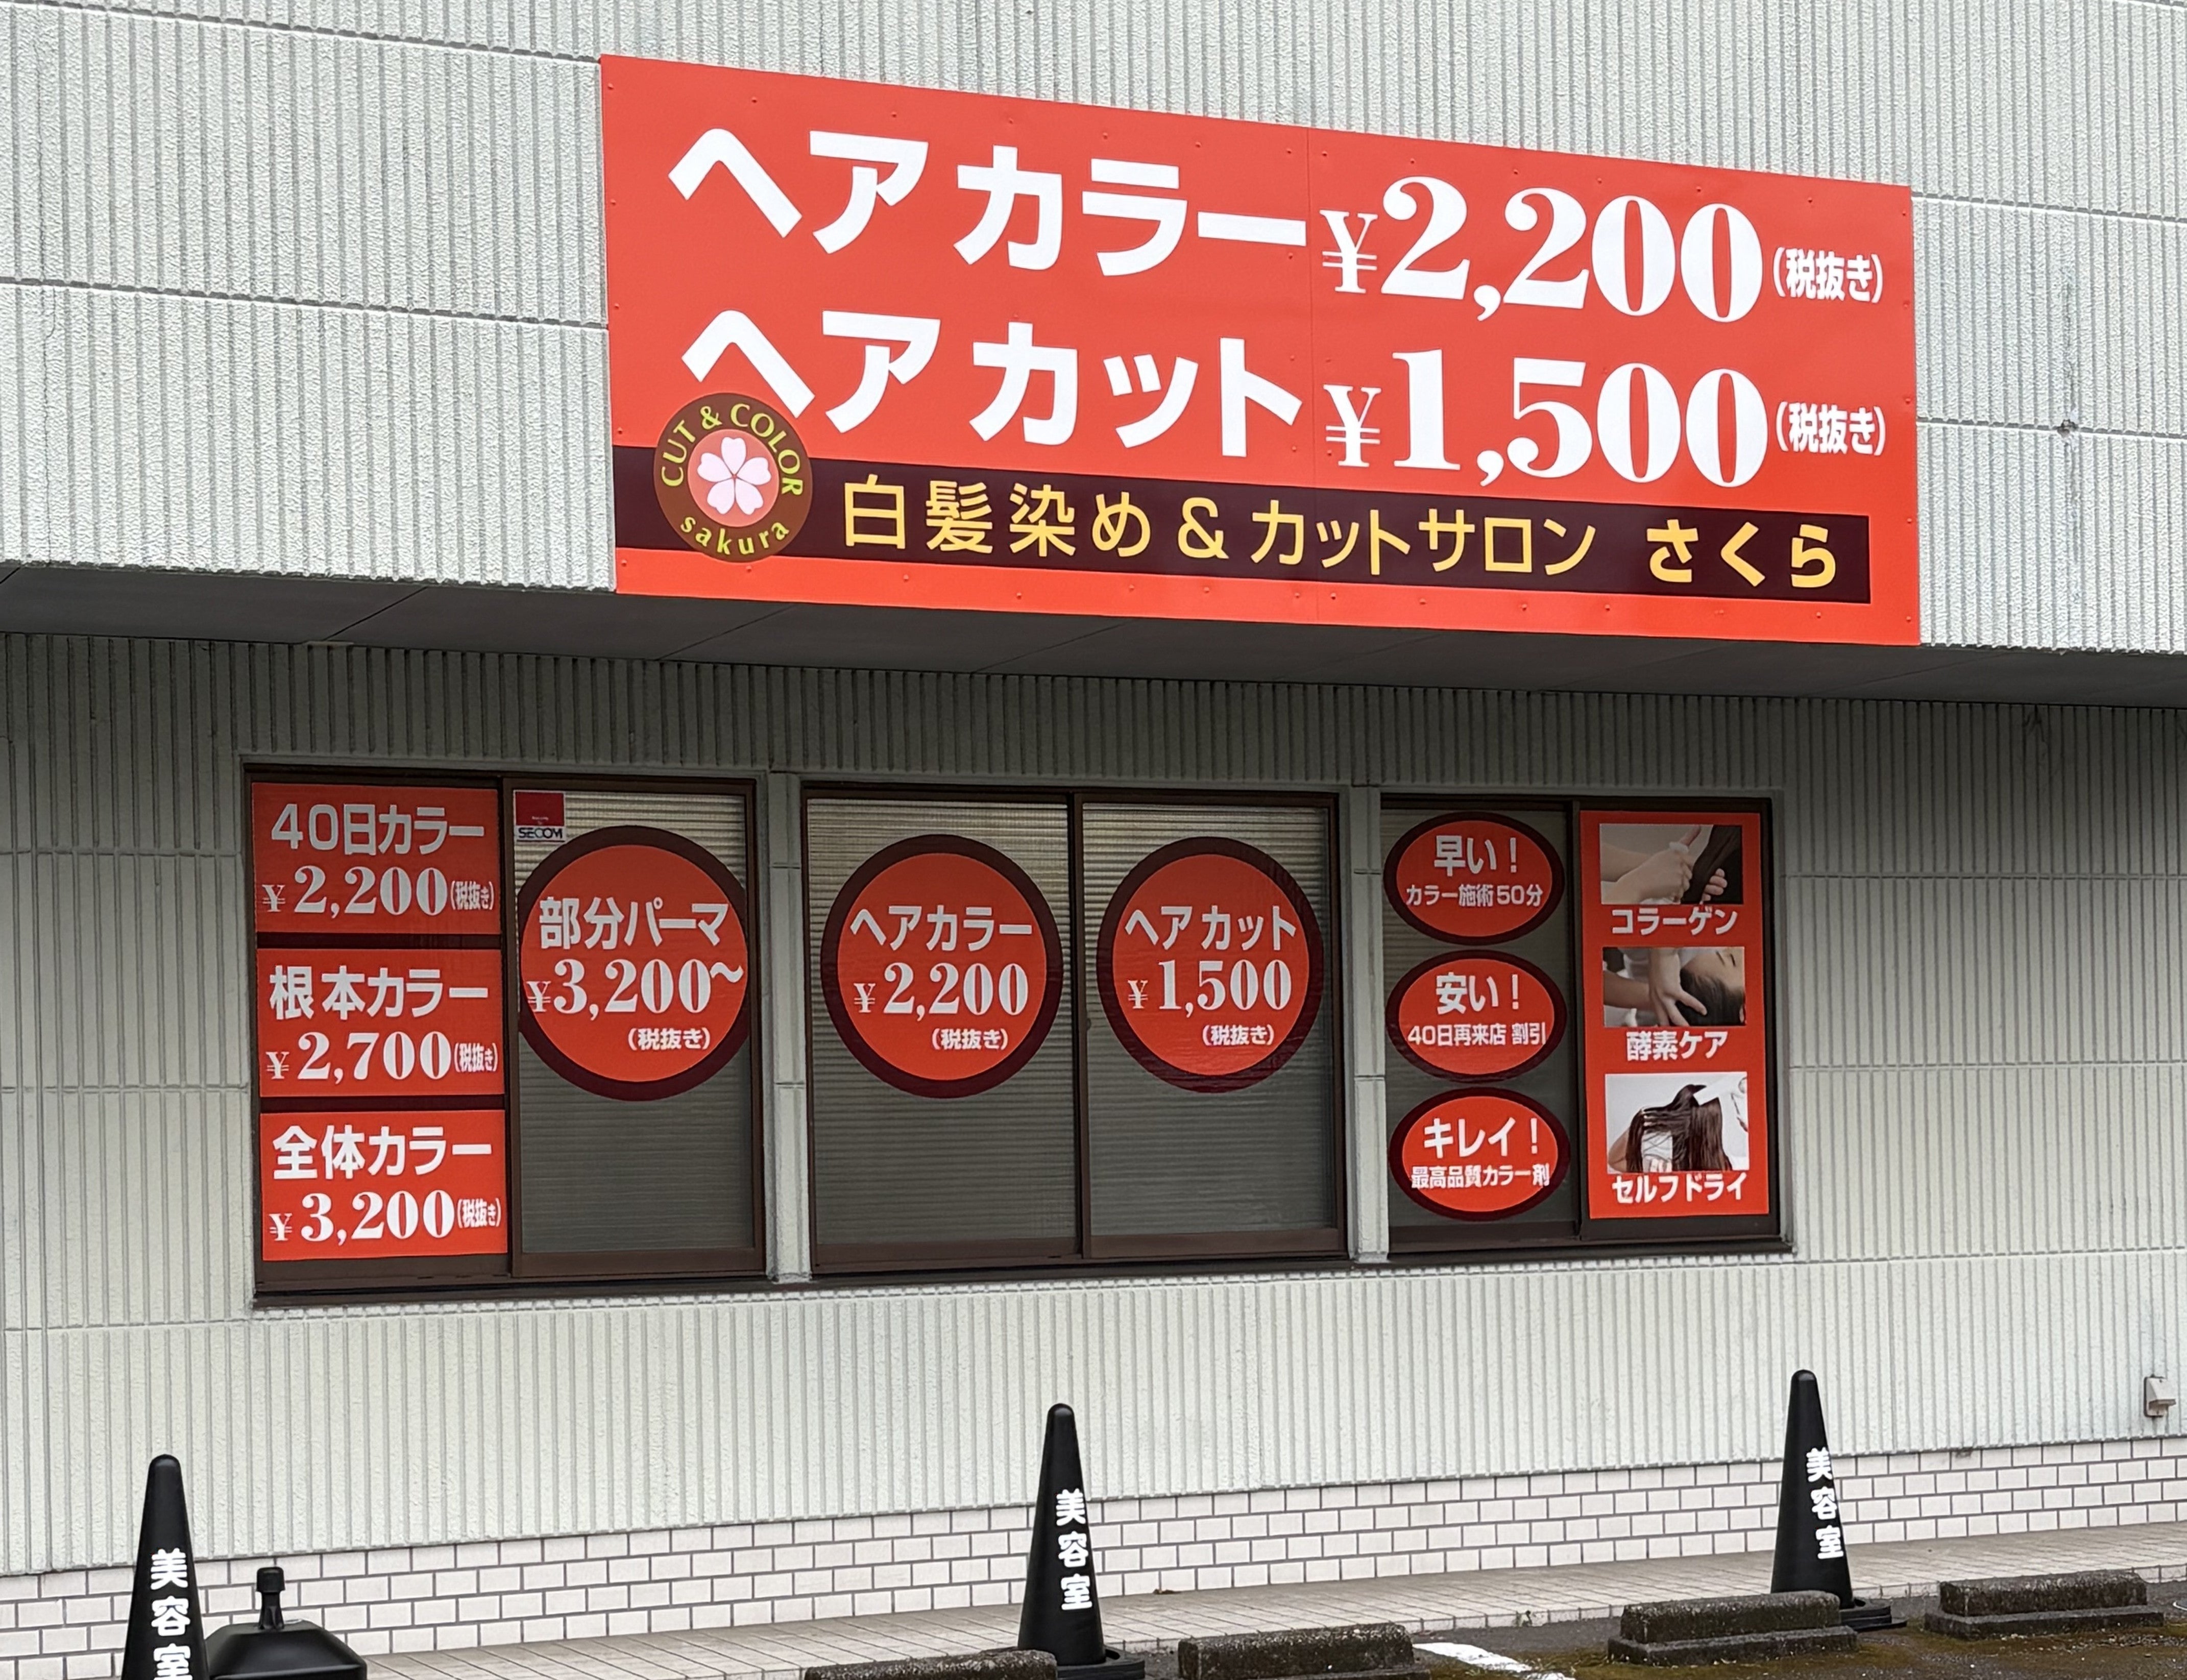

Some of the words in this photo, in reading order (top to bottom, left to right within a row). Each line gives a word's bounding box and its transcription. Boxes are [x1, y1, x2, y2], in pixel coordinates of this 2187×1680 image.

[668, 128, 1307, 276] ヘアカラー
[1320, 176, 1763, 323] ¥2,200
[1773, 247, 1883, 303] (税抜き)
[682, 310, 1302, 457] ヘアカット
[1323, 349, 1768, 487] ¥1,500
[1776, 401, 1885, 456] (税抜き)
[661, 420, 696, 486] CUT
[700, 406, 722, 429] &
[731, 403, 803, 495] COLOR
[680, 517, 789, 555] sakura
[1646, 519, 1836, 588] さくら
[271, 804, 484, 856] 40日カラー
[518, 827, 563, 839] SECOM
[539, 896, 728, 949] 部分パーマ
[850, 905, 1032, 952] ヘアカラー
[1125, 905, 1296, 951] ヘアカット
[1612, 906, 1738, 935] コラーゲン
[270, 965, 488, 1020] 根本カラー
[854, 962, 1028, 1021] ¥2,200
[1128, 959, 1292, 1018] ¥1,500
[628, 1027, 710, 1051] (税抜き)
[932, 1028, 1008, 1050] (税抜き)
[1202, 1024, 1274, 1046] (税抜き)
[1626, 1030, 1728, 1061] 酵素ケア
[273, 1125, 492, 1180] 全体カラー
[1411, 1163, 1550, 1189] 最高品質カラー剤
[1612, 1173, 1747, 1204] セルフドライ
[1806, 1447, 1843, 1559] 美容室
[1056, 1488, 1092, 1610] 美容室
